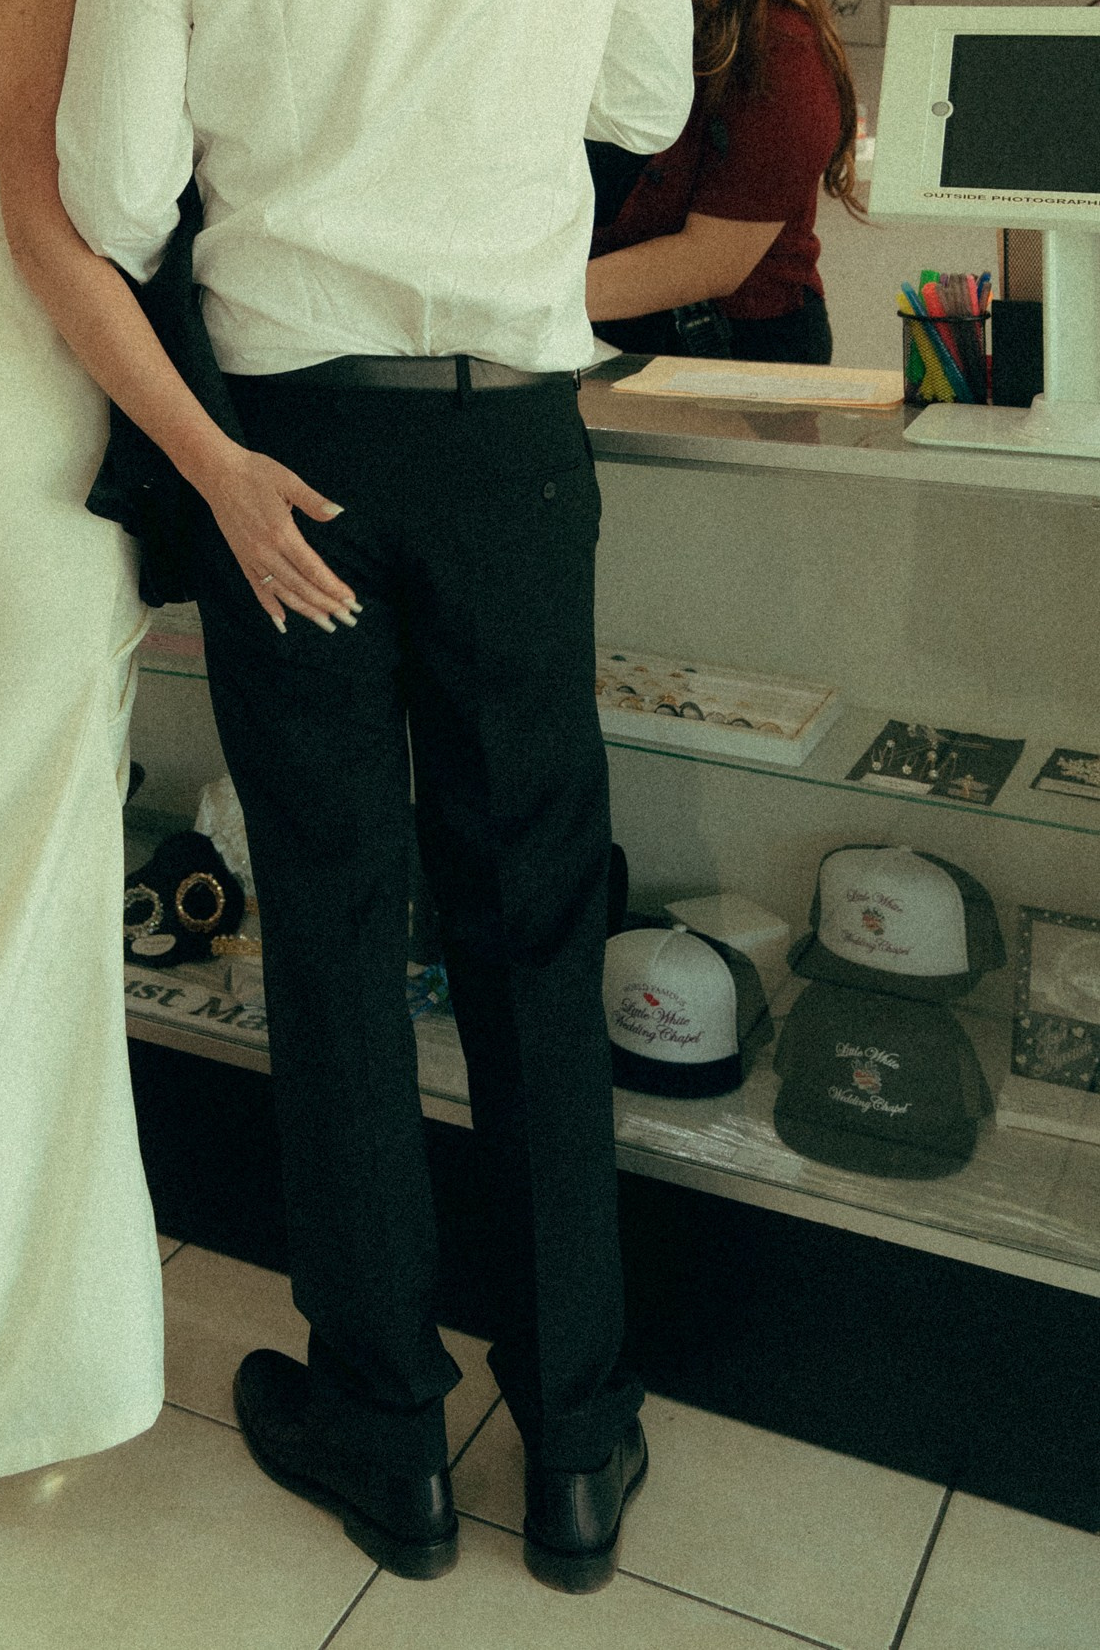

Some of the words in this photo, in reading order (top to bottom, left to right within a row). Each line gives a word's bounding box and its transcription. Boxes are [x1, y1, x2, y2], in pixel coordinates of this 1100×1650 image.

[923, 192, 987, 201] OUTSIDE
[991, 196, 1100, 205] PHOTOGRAPH
[621, 998, 650, 1019] Little
[652, 1008, 691, 1027] White
[612, 1010, 657, 1043] Wedding
[656, 1024, 705, 1048] Chapel
[836, 1042, 863, 1057] Little
[865, 1047, 900, 1069] White
[828, 1086, 872, 1113] Wedding
[870, 1095, 912, 1117] Chapel
